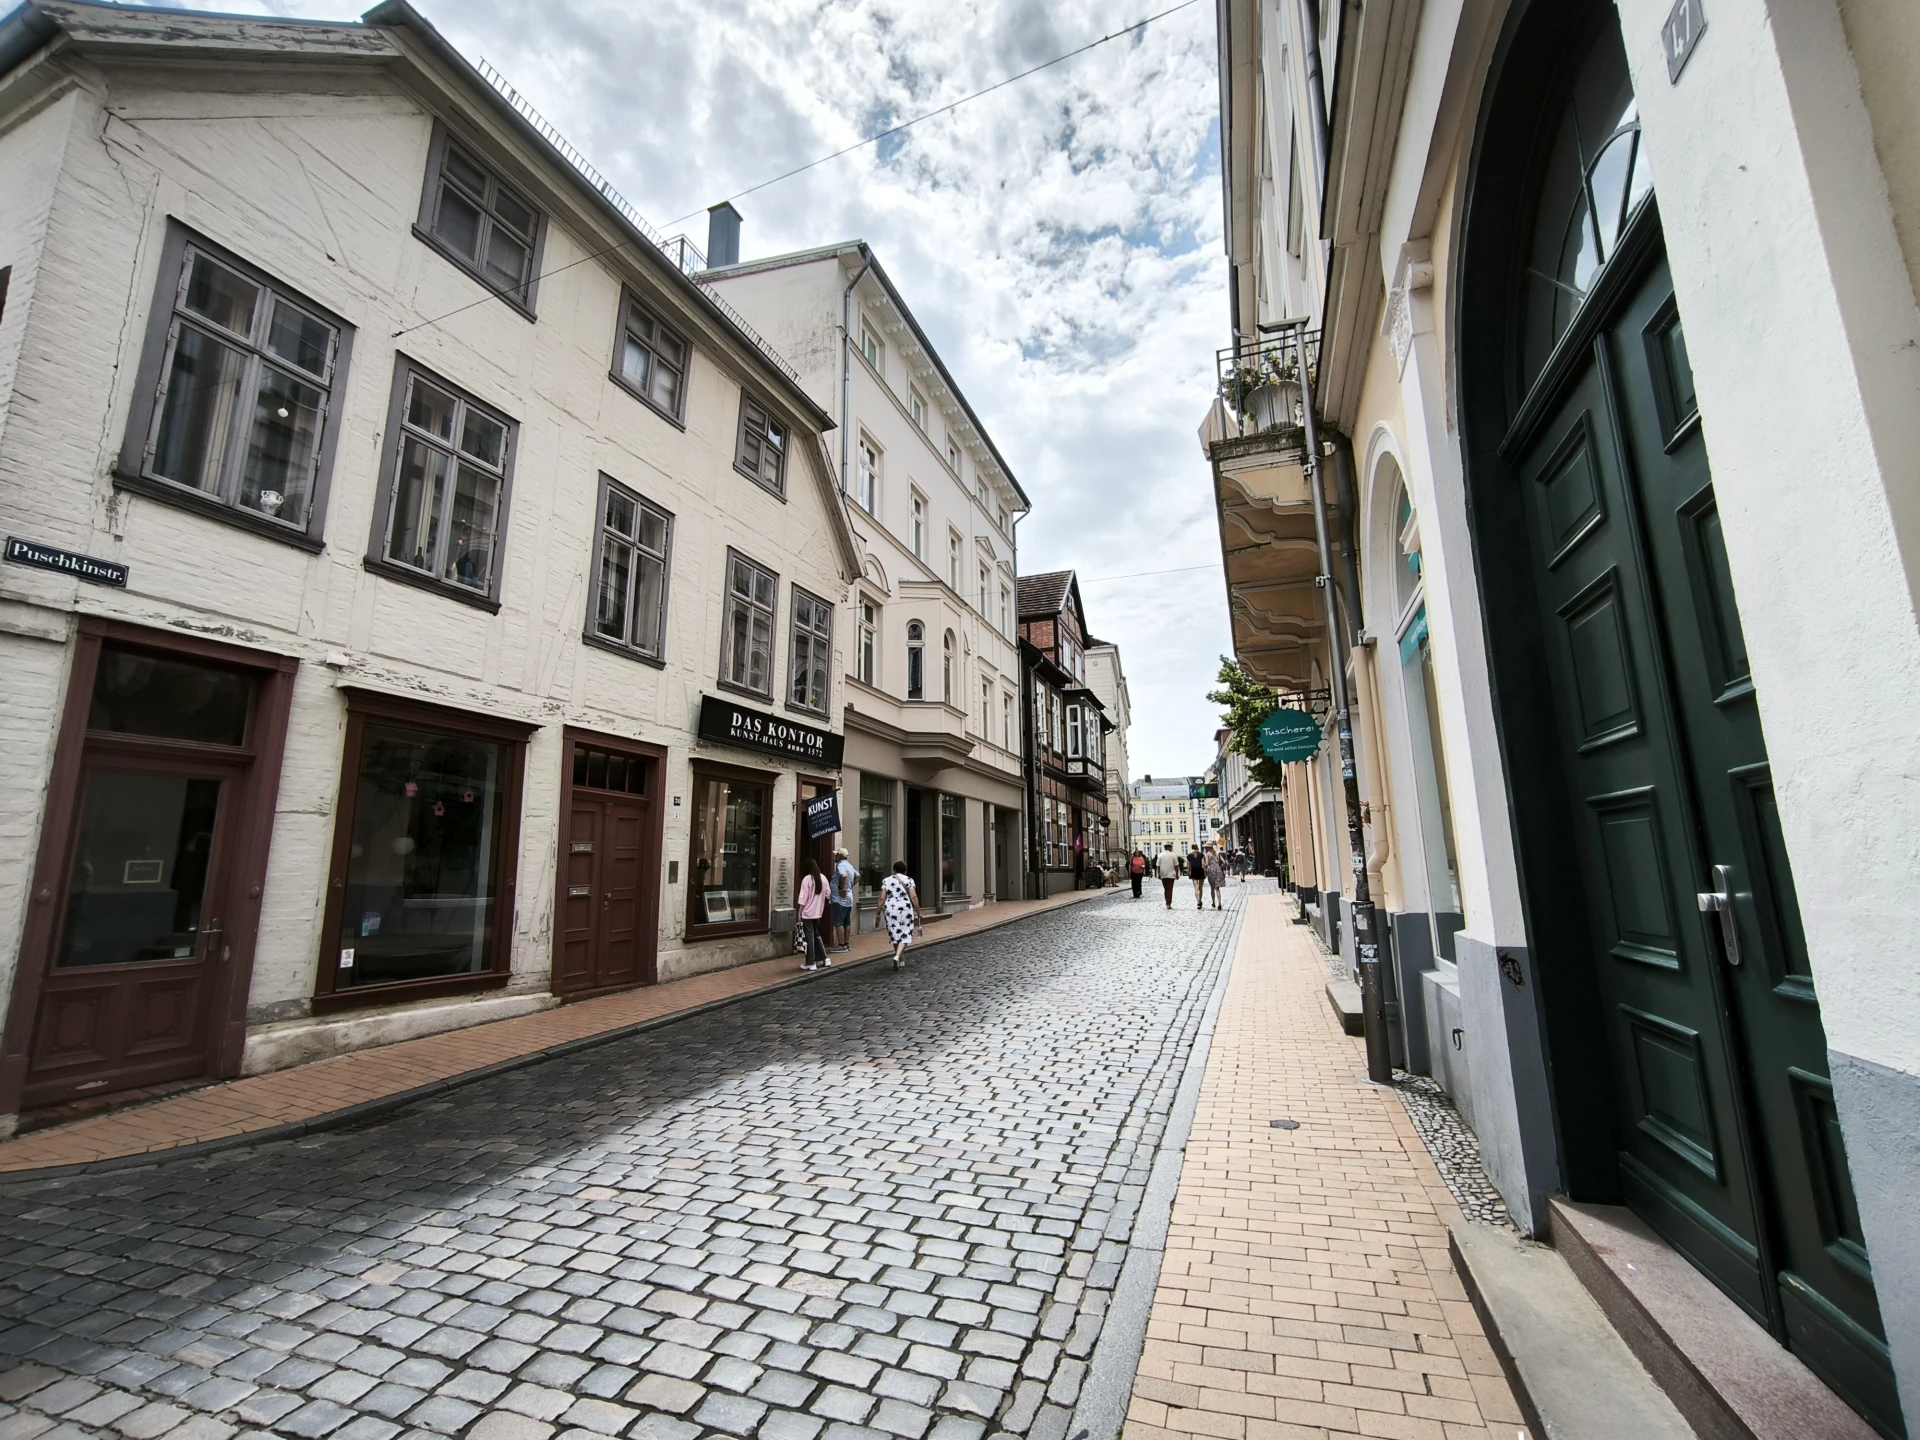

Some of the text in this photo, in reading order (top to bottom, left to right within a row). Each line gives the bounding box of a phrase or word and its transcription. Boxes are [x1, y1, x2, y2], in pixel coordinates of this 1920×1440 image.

[1672, 0, 1690, 59] 47
[13, 542, 123, 581] Puschkinstr.
[730, 727, 823, 758] KUNST-HAUS anno 1572
[731, 712, 824, 749] DAS KONTOR
[1262, 723, 1315, 736] Tuscherei
[808, 797, 833, 817] KUNST
